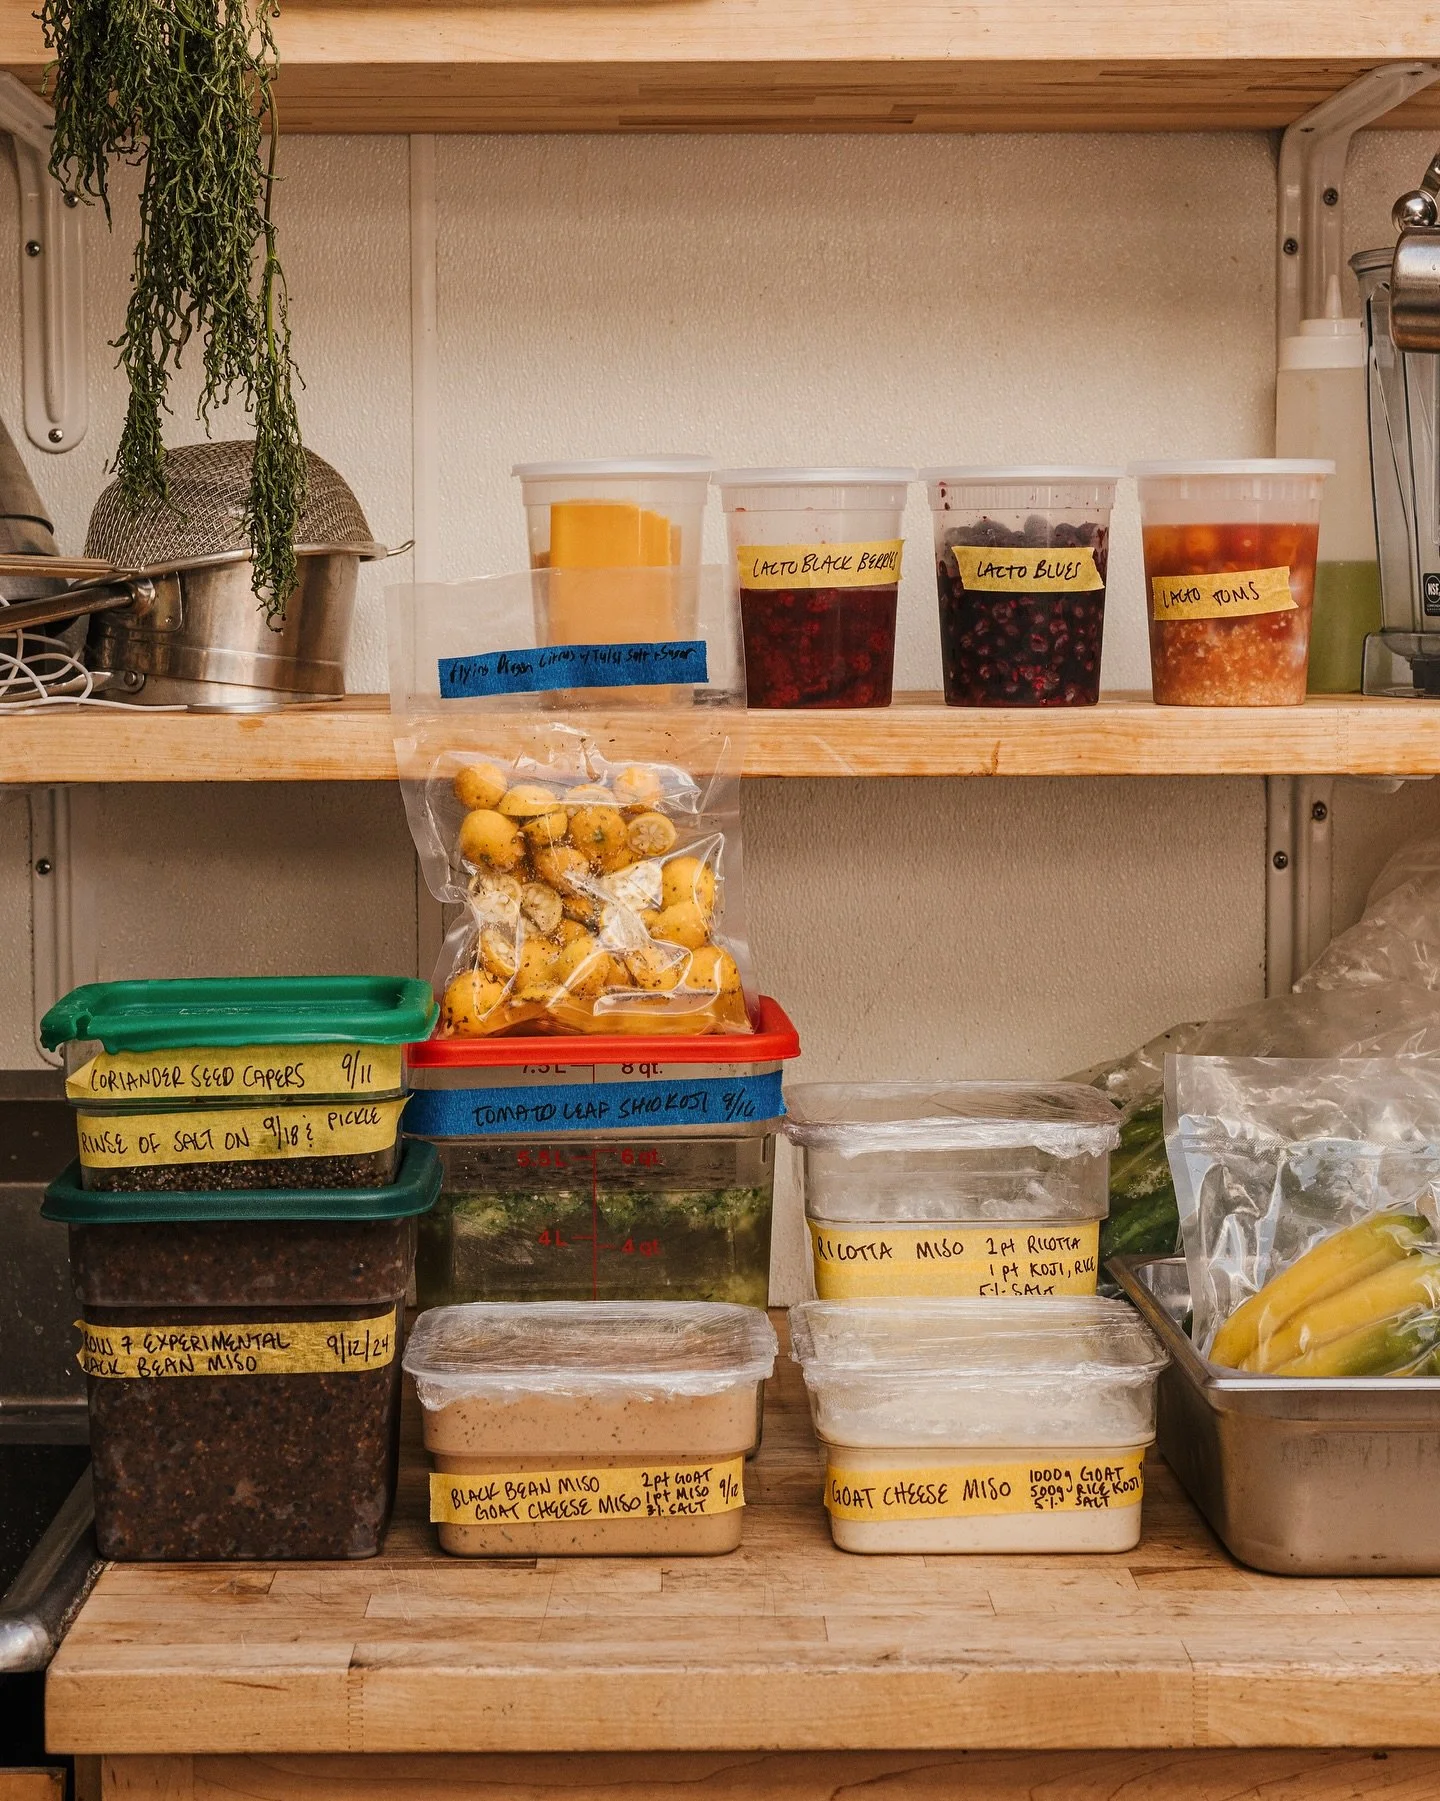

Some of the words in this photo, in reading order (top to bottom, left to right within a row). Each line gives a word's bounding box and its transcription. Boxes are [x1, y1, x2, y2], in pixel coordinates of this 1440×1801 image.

[753, 558, 798, 577] LACTO
[801, 553, 852, 573] BLACK
[977, 561, 1027, 579] LACTO
[1033, 559, 1082, 580] BLUES
[1162, 587, 1200, 608] LACTO
[1213, 581, 1260, 606] TOMS
[1428, 583, 1439, 595] NSF
[91, 1066, 185, 1092] CORIANDER
[191, 1064, 235, 1088] SEED
[243, 1063, 305, 1090] CAPERS
[341, 1050, 371, 1089] 9/11
[563, 1101, 609, 1120] LEAF
[81, 1131, 128, 1154] RINSE
[139, 1133, 160, 1153] OF
[174, 1129, 215, 1152] SALT
[225, 1127, 250, 1150] ON
[263, 1115, 299, 1150] 9/18
[328, 1107, 381, 1131] PICKLE
[538, 1229, 551, 1246] 4
[621, 1239, 634, 1256] 4
[817, 1236, 893, 1261] RICOTTA
[916, 1238, 964, 1259] MISO
[1027, 1235, 1081, 1254] RICOTTA
[121, 1336, 133, 1354] 7
[143, 1331, 290, 1354] EXPERIMENTAL
[327, 1329, 389, 1364] 9/12/24
[137, 1354, 195, 1377] BEAN
[208, 1354, 257, 1372] MISO
[674, 1468, 713, 1485] GOAT
[1080, 1466, 1124, 1482] GOAT
[451, 1482, 500, 1510] BLACK
[504, 1477, 550, 1500] BEAN
[559, 1475, 600, 1494] MISO
[676, 1485, 709, 1500] MISO
[832, 1480, 876, 1509] GOAT
[883, 1481, 949, 1506] CHEESE
[962, 1477, 1012, 1501] MISO
[1030, 1485, 1065, 1502] 500g
[1077, 1482, 1110, 1496] RICE
[1112, 1477, 1140, 1495] KOJI
[475, 1502, 520, 1520] GOAT
[528, 1498, 592, 1519] CHEESE
[599, 1494, 641, 1513] MISO
[669, 1499, 707, 1515] SALT
[1075, 1496, 1110, 1508] SALT
